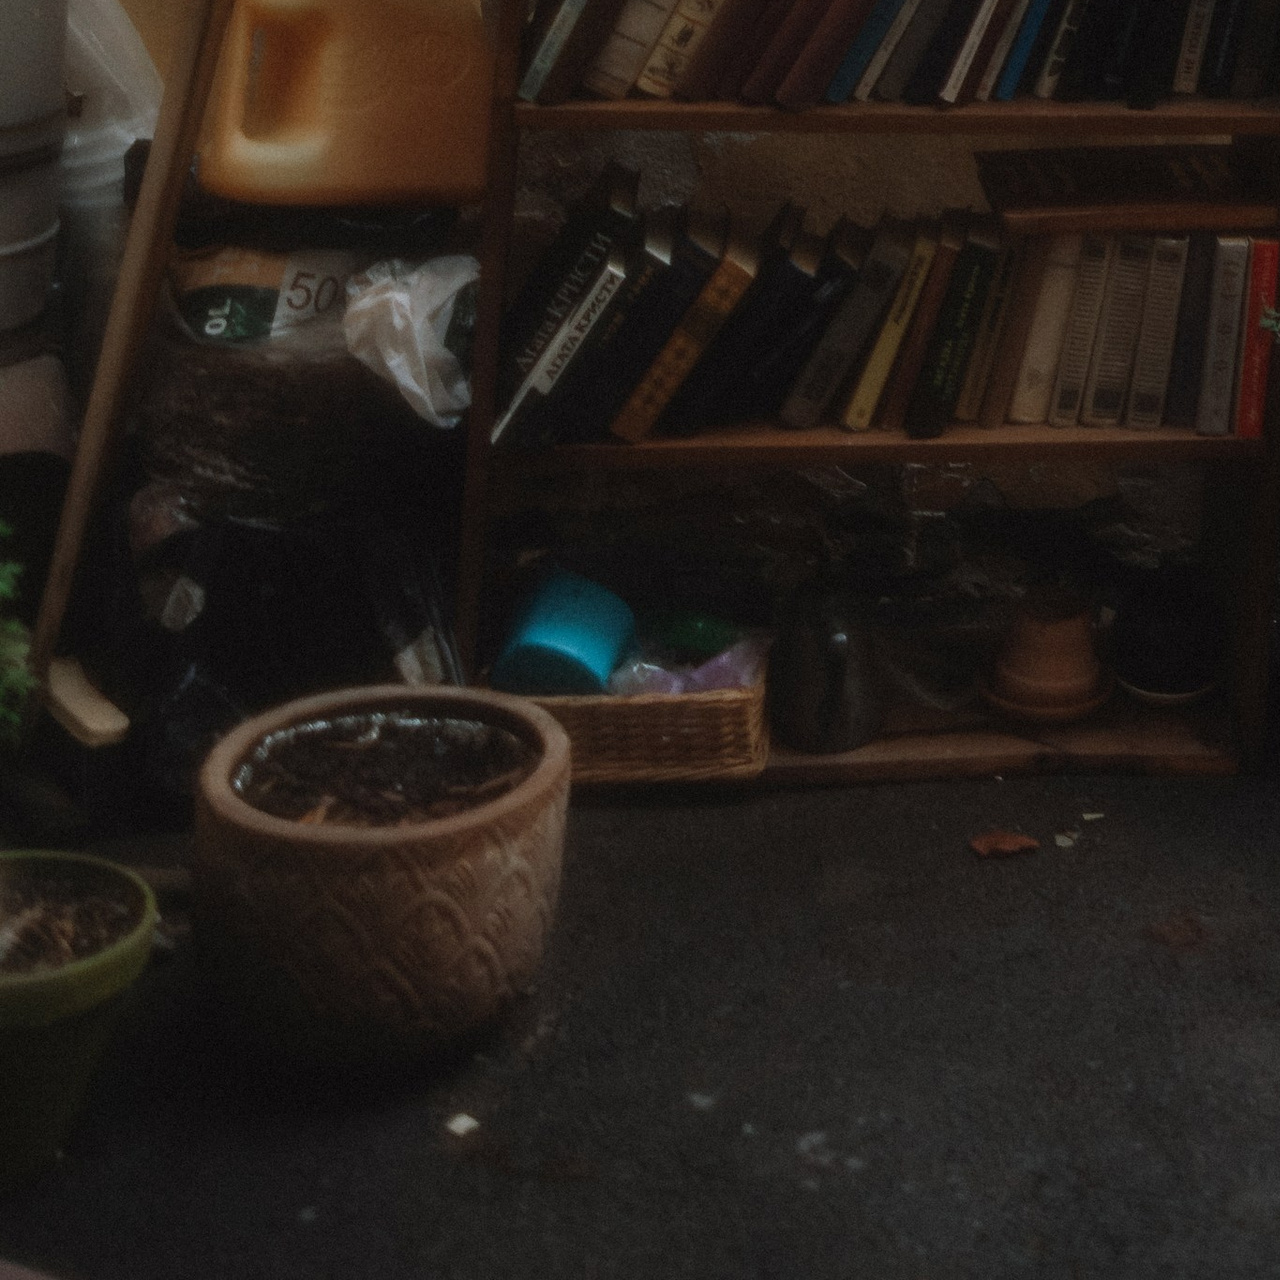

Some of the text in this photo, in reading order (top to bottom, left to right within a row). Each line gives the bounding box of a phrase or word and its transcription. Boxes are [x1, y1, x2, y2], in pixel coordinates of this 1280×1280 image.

[286, 271, 339, 313] 50
[545, 229, 613, 320] КРИСТИ
[543, 271, 620, 381] АГАТА КРИСТИ
